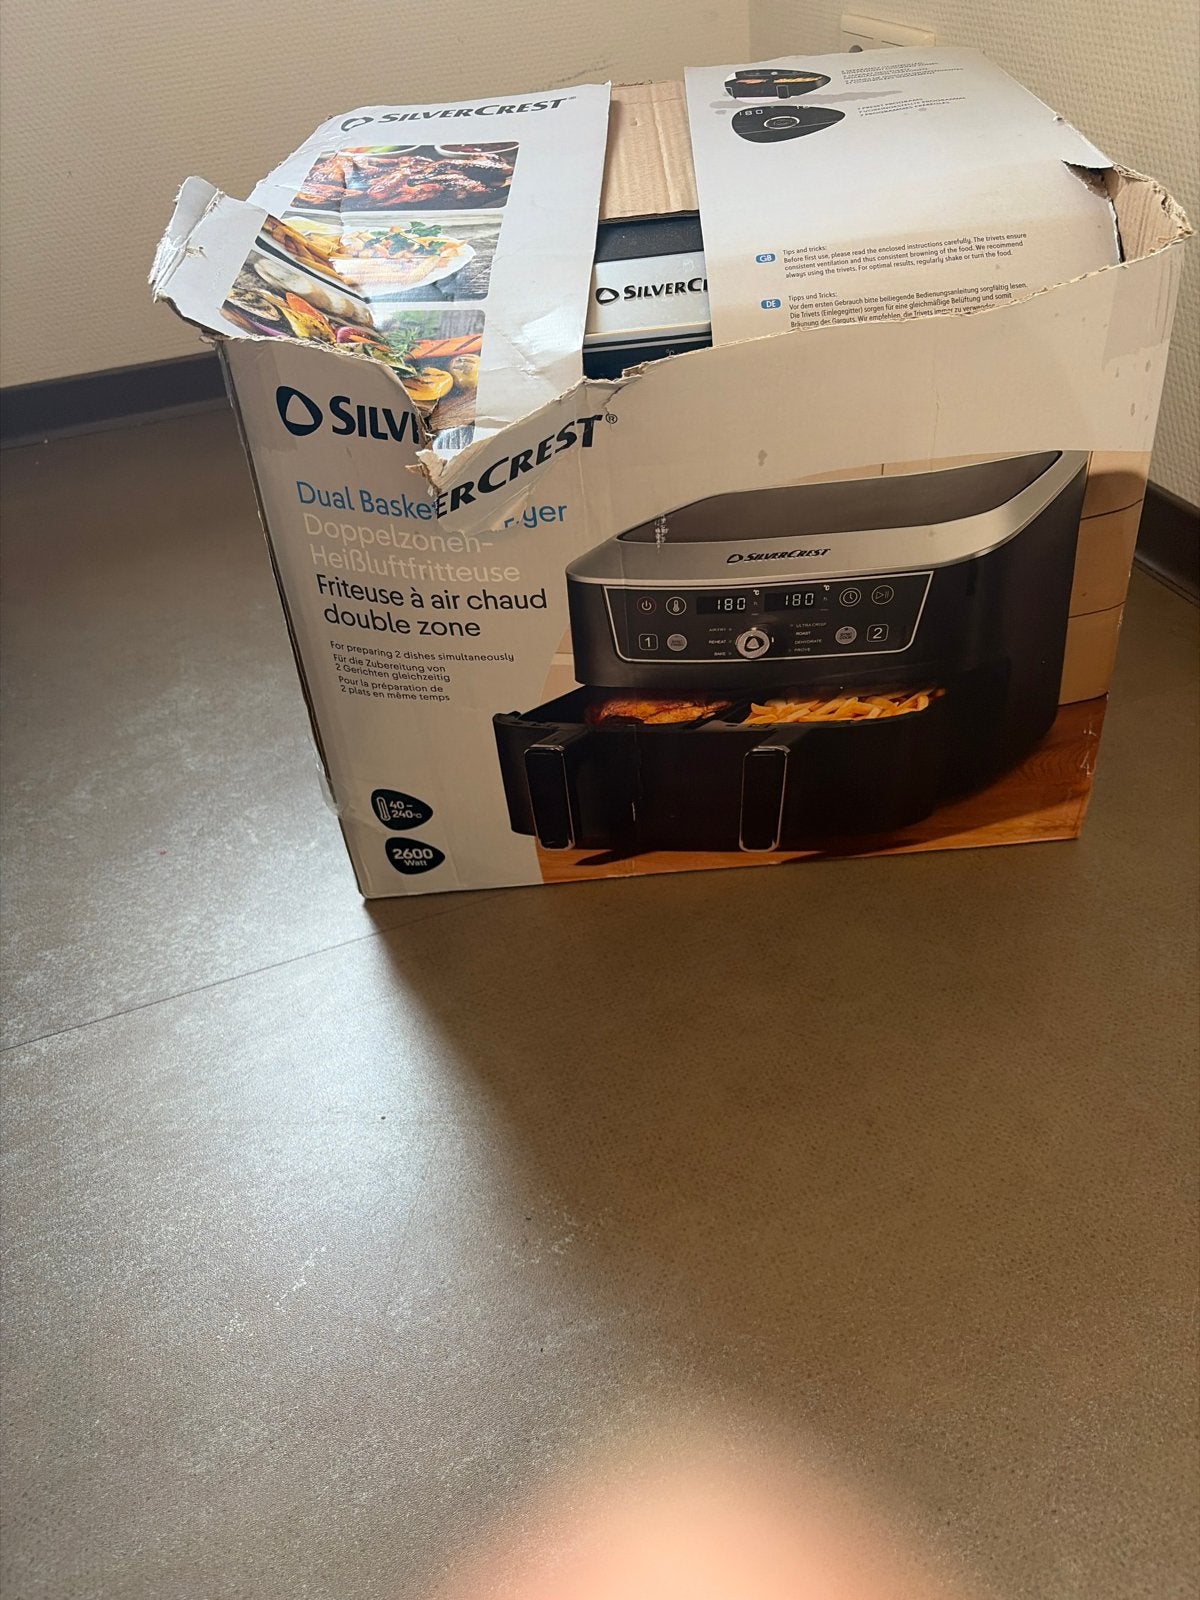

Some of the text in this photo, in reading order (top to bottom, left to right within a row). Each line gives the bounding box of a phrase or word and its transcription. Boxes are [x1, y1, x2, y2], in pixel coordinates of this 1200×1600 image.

[784, 256, 804, 264] Before
[832, 250, 851, 259] please
[878, 244, 906, 253] enclosed
[907, 241, 943, 250] instructions
[784, 262, 816, 271] consistent
[816, 259, 849, 268] ventilation
[878, 252, 908, 262] consistent
[910, 248, 939, 258] browning
[987, 241, 1024, 250] recommend
[786, 270, 806, 279] always
[808, 268, 824, 277] using
[836, 265, 858, 273] trivets.
[869, 262, 892, 271] optimal
[916, 256, 944, 266] regularly
[834, 298, 864, 306] Gebrauch
[880, 293, 914, 304] beiliegende
[916, 286, 979, 298] Bedienungsanleitung
[980, 284, 1009, 292] sorgfältig
[801, 310, 820, 318] Trivets
[821, 306, 863, 317] (Einlegegitter)
[864, 305, 884, 314] sorgen
[908, 299, 950, 309] gleichmäßige
[951, 296, 981, 305] Belüftung
[296, 481, 355, 510] Dual
[358, 490, 437, 520] Baske
[303, 513, 494, 553] Doppelzonen-
[310, 544, 520, 582] Heißluftfritteuse
[744, 548, 831, 561] SILVERCREST
[316, 574, 548, 610] Friteuse à air chaud
[785, 592, 814, 606] 180
[718, 598, 746, 611] 180
[324, 604, 481, 636] double zone
[644, 636, 651, 648] 1
[872, 627, 883, 640] 2
[330, 640, 514, 662] For preparing 2 dishes simultaneously
[333, 653, 348, 664] Für
[349, 656, 364, 666] die
[366, 659, 425, 673] Zubereitung
[336, 663, 450, 683] 2 Gerichten gleichzeitig
[338, 675, 444, 693] Pour la préparation de
[341, 684, 450, 702] 2 plats en même temps
[392, 848, 434, 860] 2600
